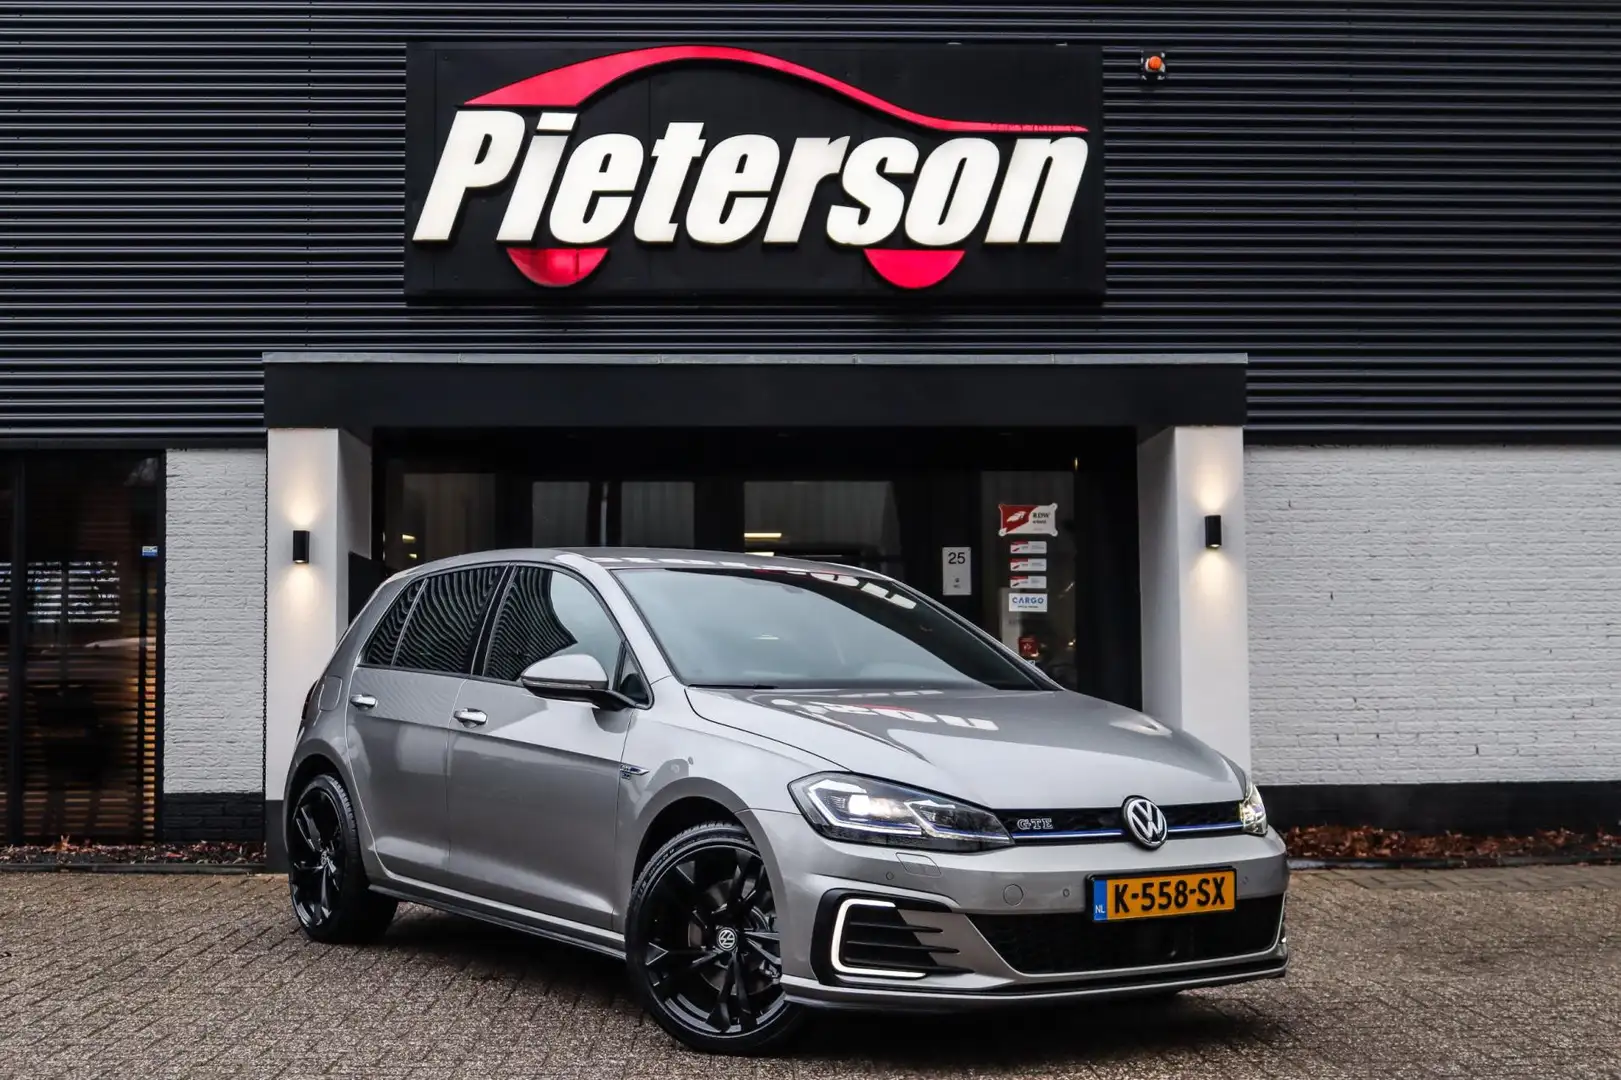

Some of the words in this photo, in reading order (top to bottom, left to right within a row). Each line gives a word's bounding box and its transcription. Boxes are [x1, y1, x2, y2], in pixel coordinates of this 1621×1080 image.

[412, 109, 1089, 246] Pieterson
[948, 552, 966, 564] 25
[1017, 818, 1053, 830] GTE
[1095, 904, 1106, 913] NL
[1114, 876, 1225, 914] K-558-SX
